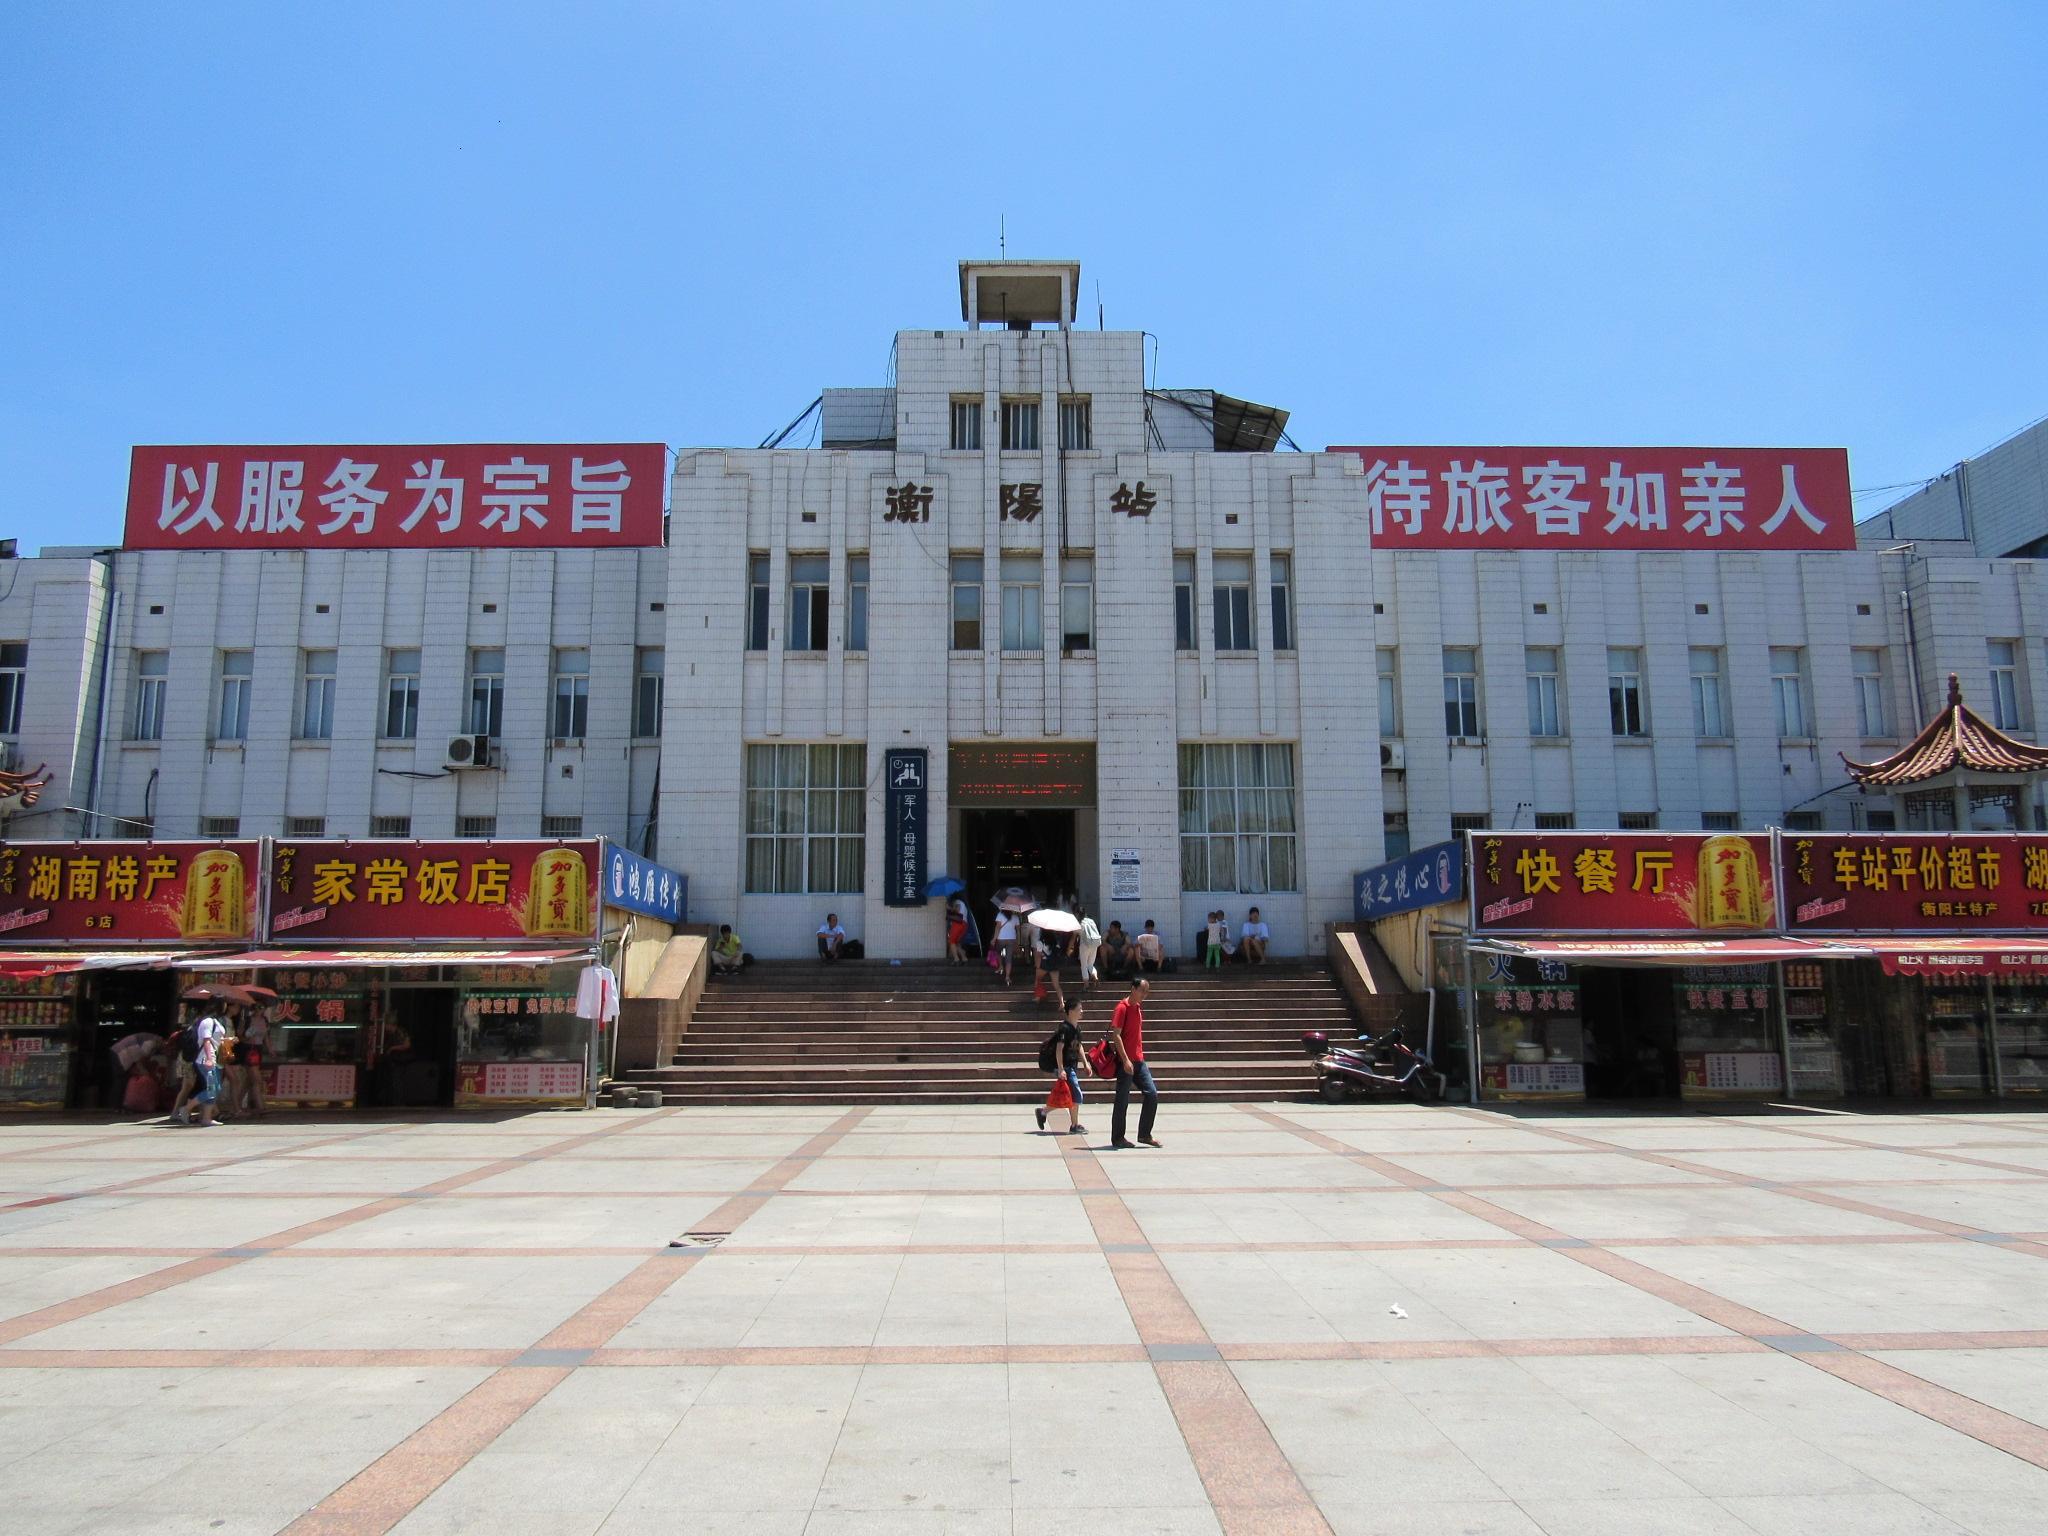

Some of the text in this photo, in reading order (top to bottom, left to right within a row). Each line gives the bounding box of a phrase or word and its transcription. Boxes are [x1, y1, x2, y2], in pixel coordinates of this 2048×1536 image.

[157, 457, 632, 535] 以服务为宗旨
[1367, 459, 1827, 537] 待旅客如亲人
[29, 855, 178, 901] 湖南特产
[312, 858, 510, 905] 家常饭店
[1515, 848, 1674, 895] 快餐厅
[1834, 846, 2000, 892] 车站平价超市
[1922, 902, 1999, 916] 衡阳土特产
[274, 1000, 345, 1022] 火锅
